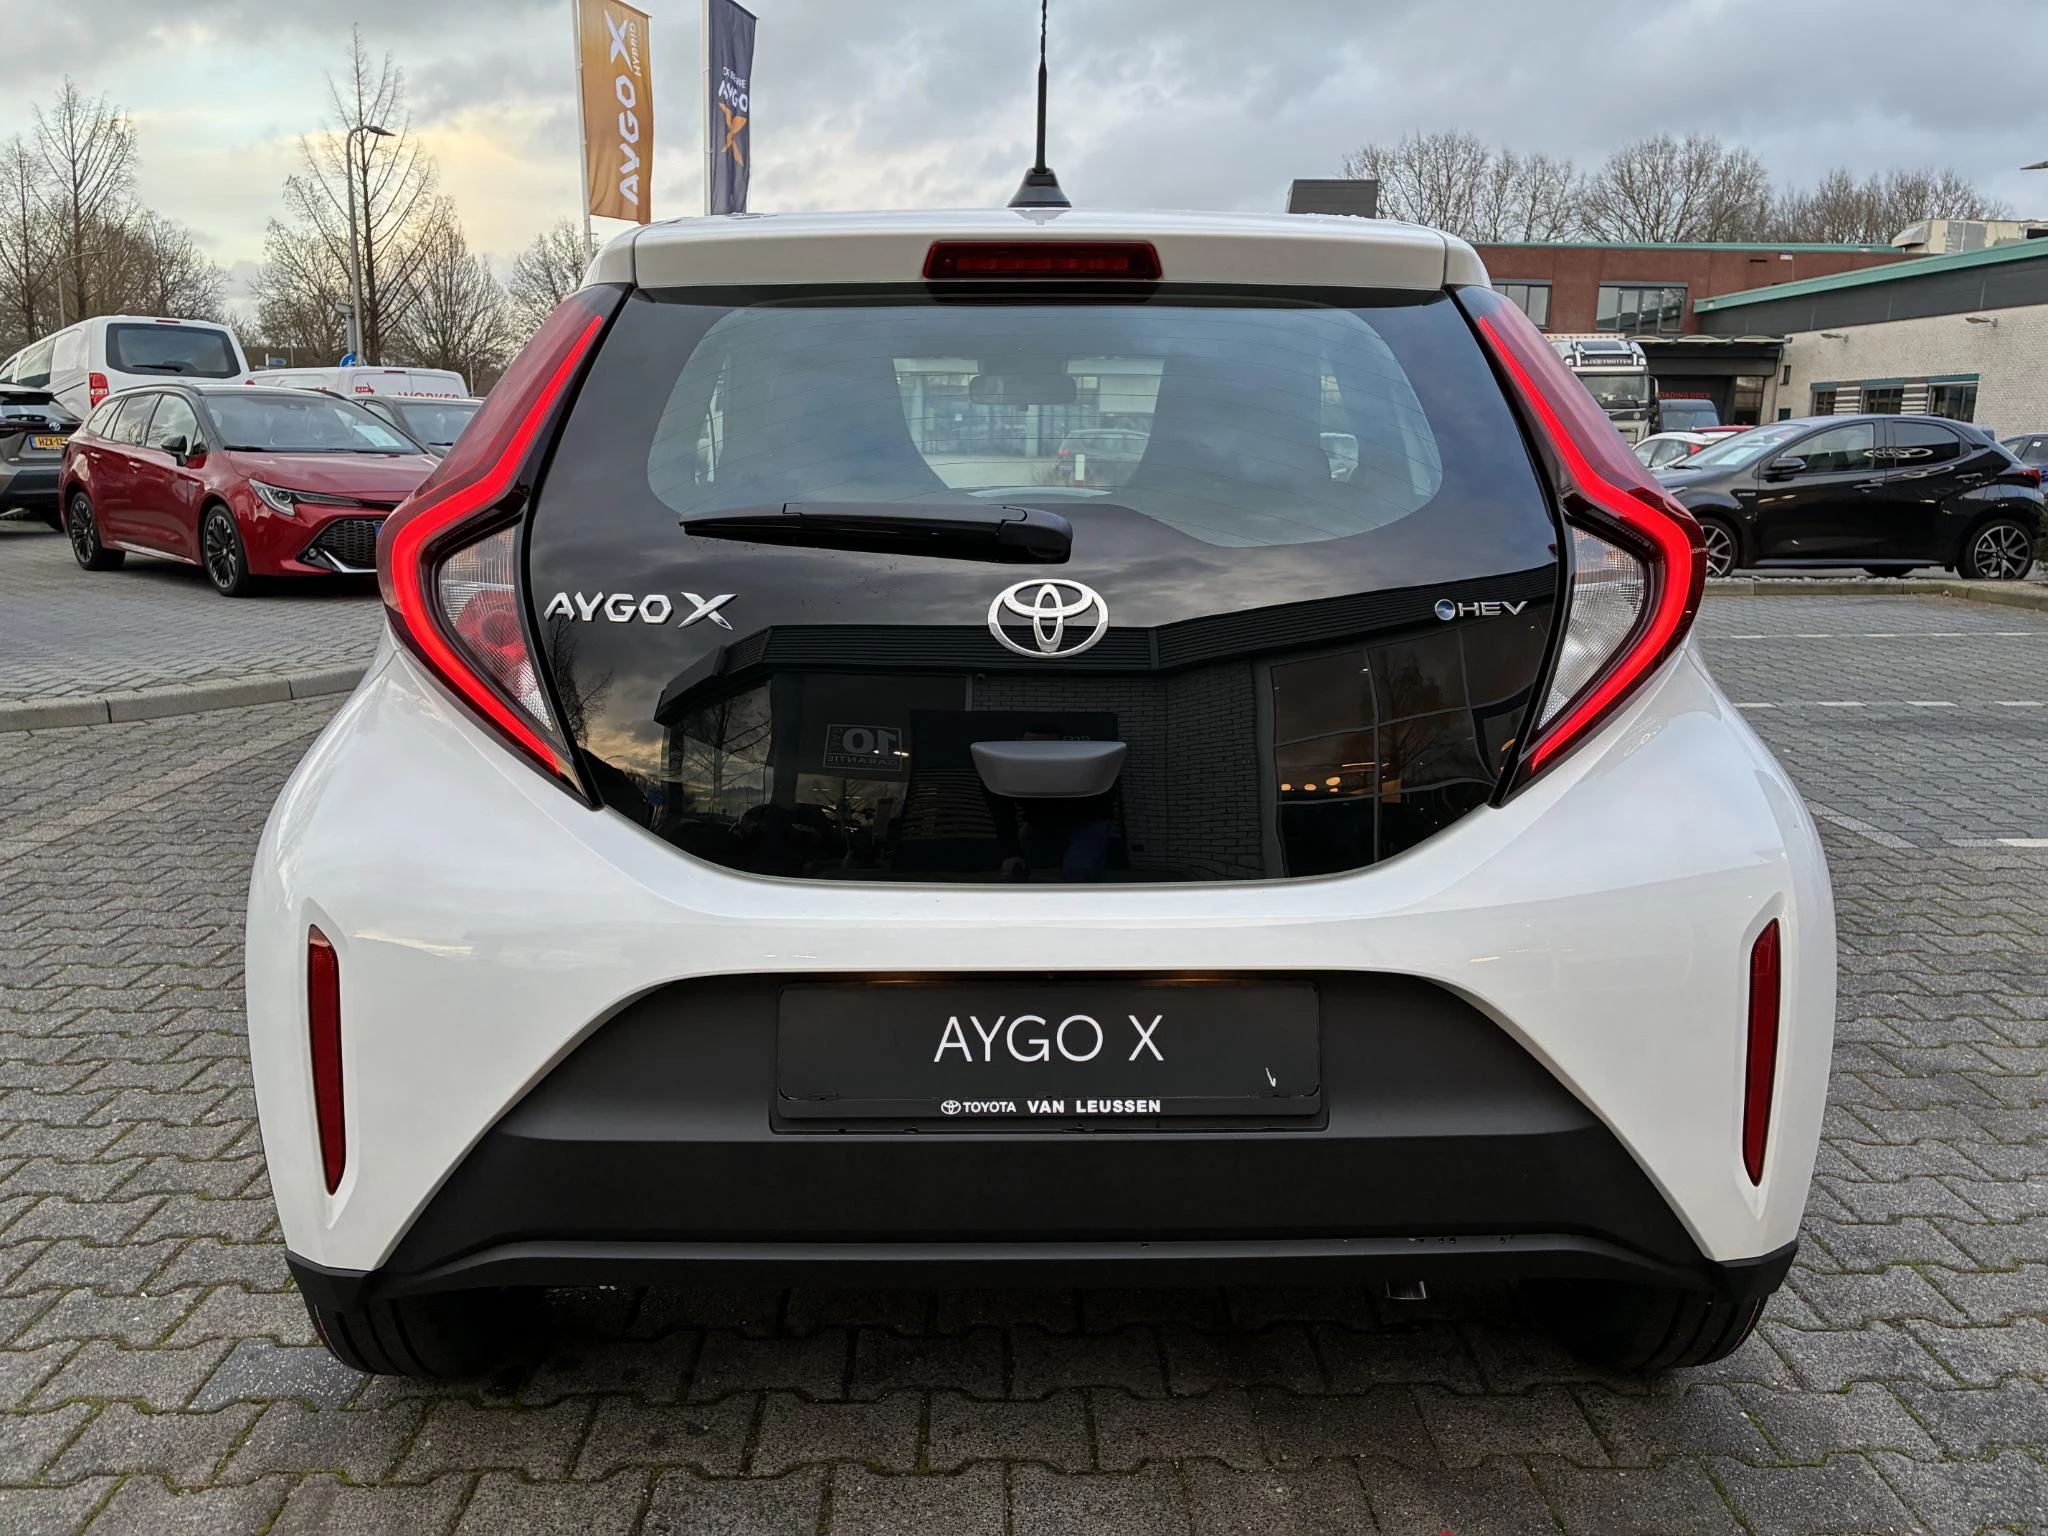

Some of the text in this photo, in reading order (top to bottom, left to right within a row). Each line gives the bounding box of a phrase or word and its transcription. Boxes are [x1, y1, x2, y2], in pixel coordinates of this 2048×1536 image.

[629, 22, 642, 77] HYBRID
[718, 80, 748, 113] AYGO
[616, 75, 640, 205] AYGO
[543, 591, 738, 631] AYGO X
[1457, 600, 1528, 617] HEV
[933, 1014, 1165, 1062] AYGO X
[963, 1099, 1161, 1114] TOYOTA VAN LEUSSEN
